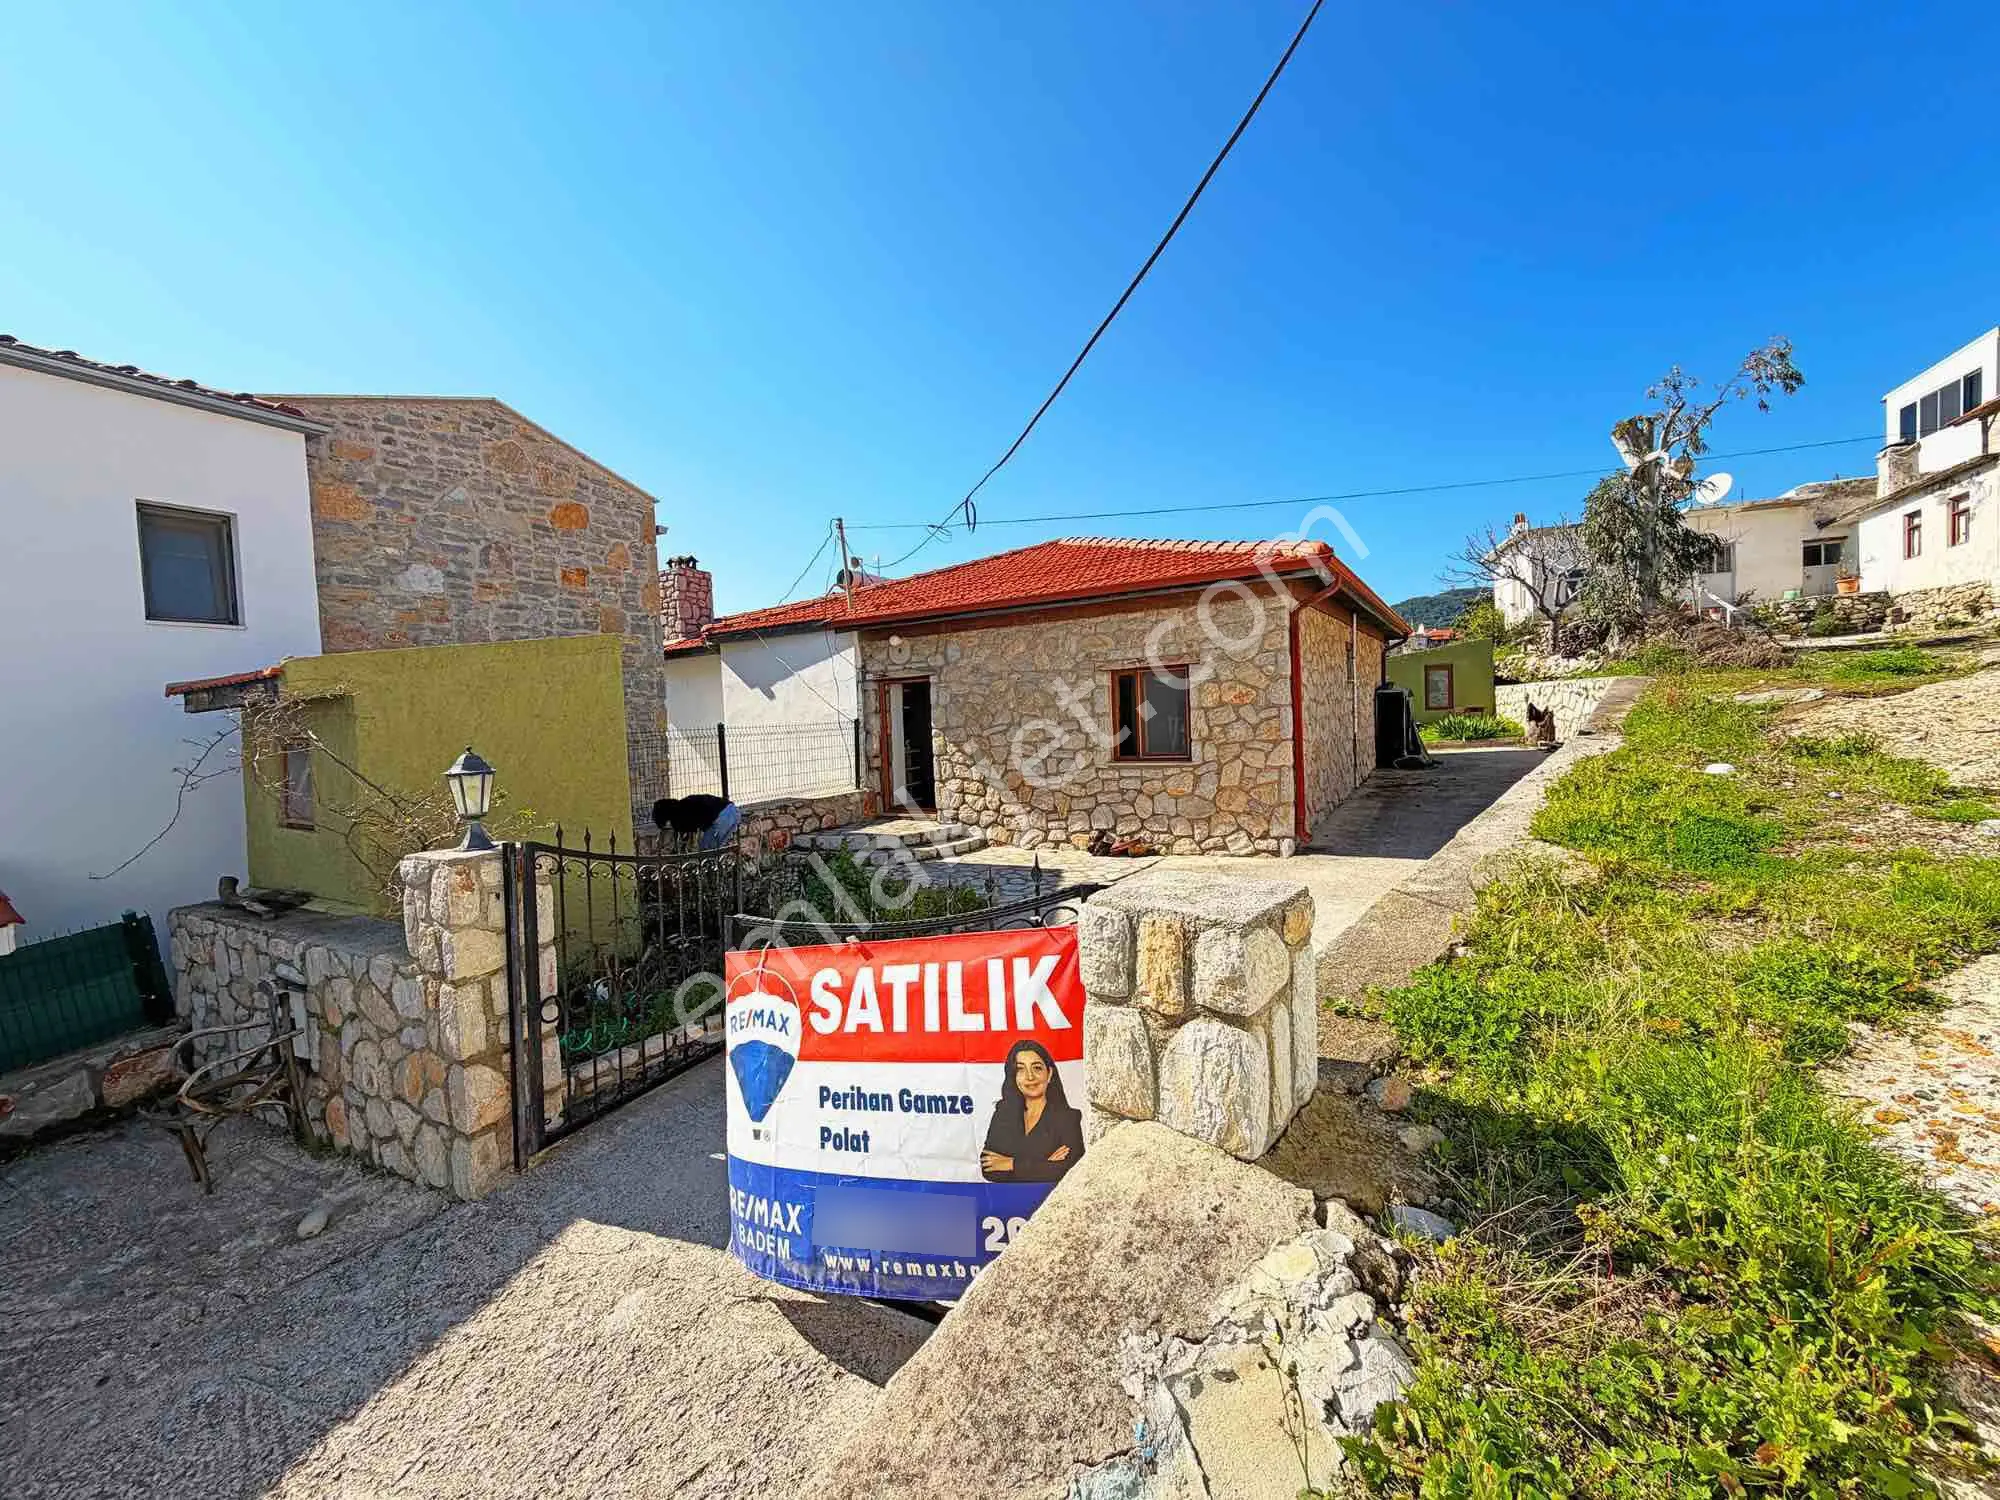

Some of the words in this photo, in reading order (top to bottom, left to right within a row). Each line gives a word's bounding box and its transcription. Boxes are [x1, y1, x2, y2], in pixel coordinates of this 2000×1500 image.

[808, 955, 1072, 1035] SATILIK
[729, 1008, 790, 1036] RE/MAX
[819, 1085, 893, 1112] Perihan
[899, 1088, 974, 1115] Gamze
[819, 1126, 871, 1153] Polat
[729, 1184, 803, 1236] RE/MAX
[738, 1222, 790, 1260] BADEM
